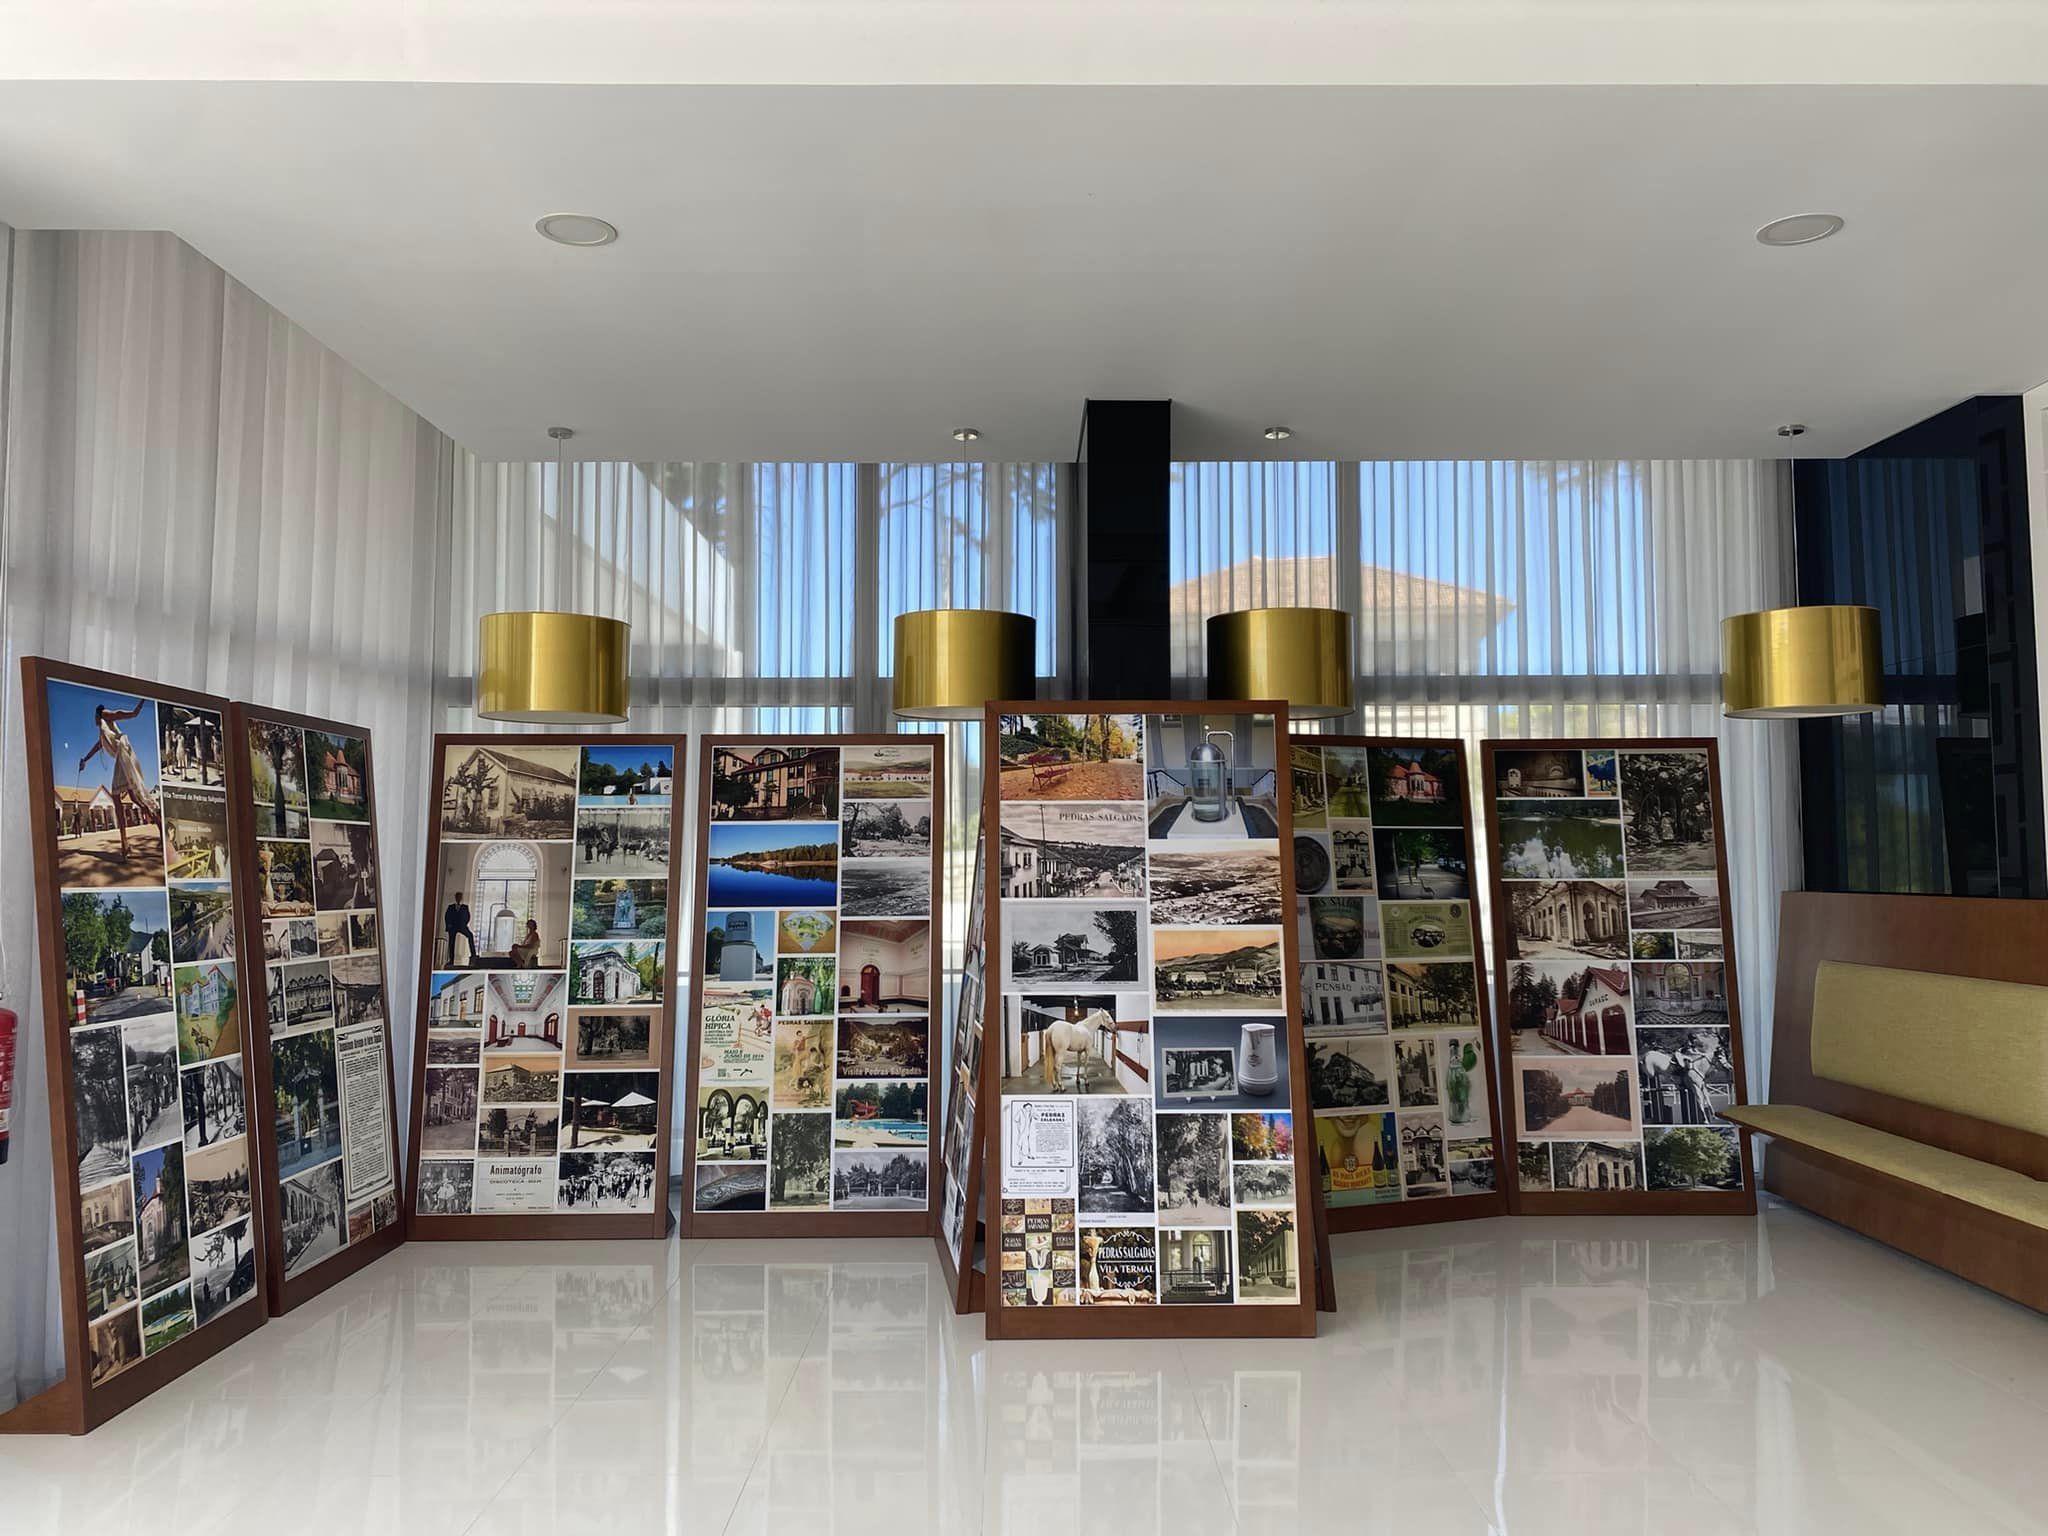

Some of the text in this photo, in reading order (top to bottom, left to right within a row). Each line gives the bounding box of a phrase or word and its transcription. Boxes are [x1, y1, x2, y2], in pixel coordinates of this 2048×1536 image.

[1059, 813, 1144, 822] PEDRAS SALGADAS
[705, 1014, 736, 1022] GLÓRIA
[704, 1022, 732, 1030] HÍPICA
[864, 1067, 889, 1076] Pedras
[890, 1066, 922, 1076] Salgadas
[490, 1164, 542, 1178] Animatógrafo
[1098, 1246, 1156, 1258] PEDRAS SALGADAS
[1100, 1264, 1154, 1273] VILA TERMAL
